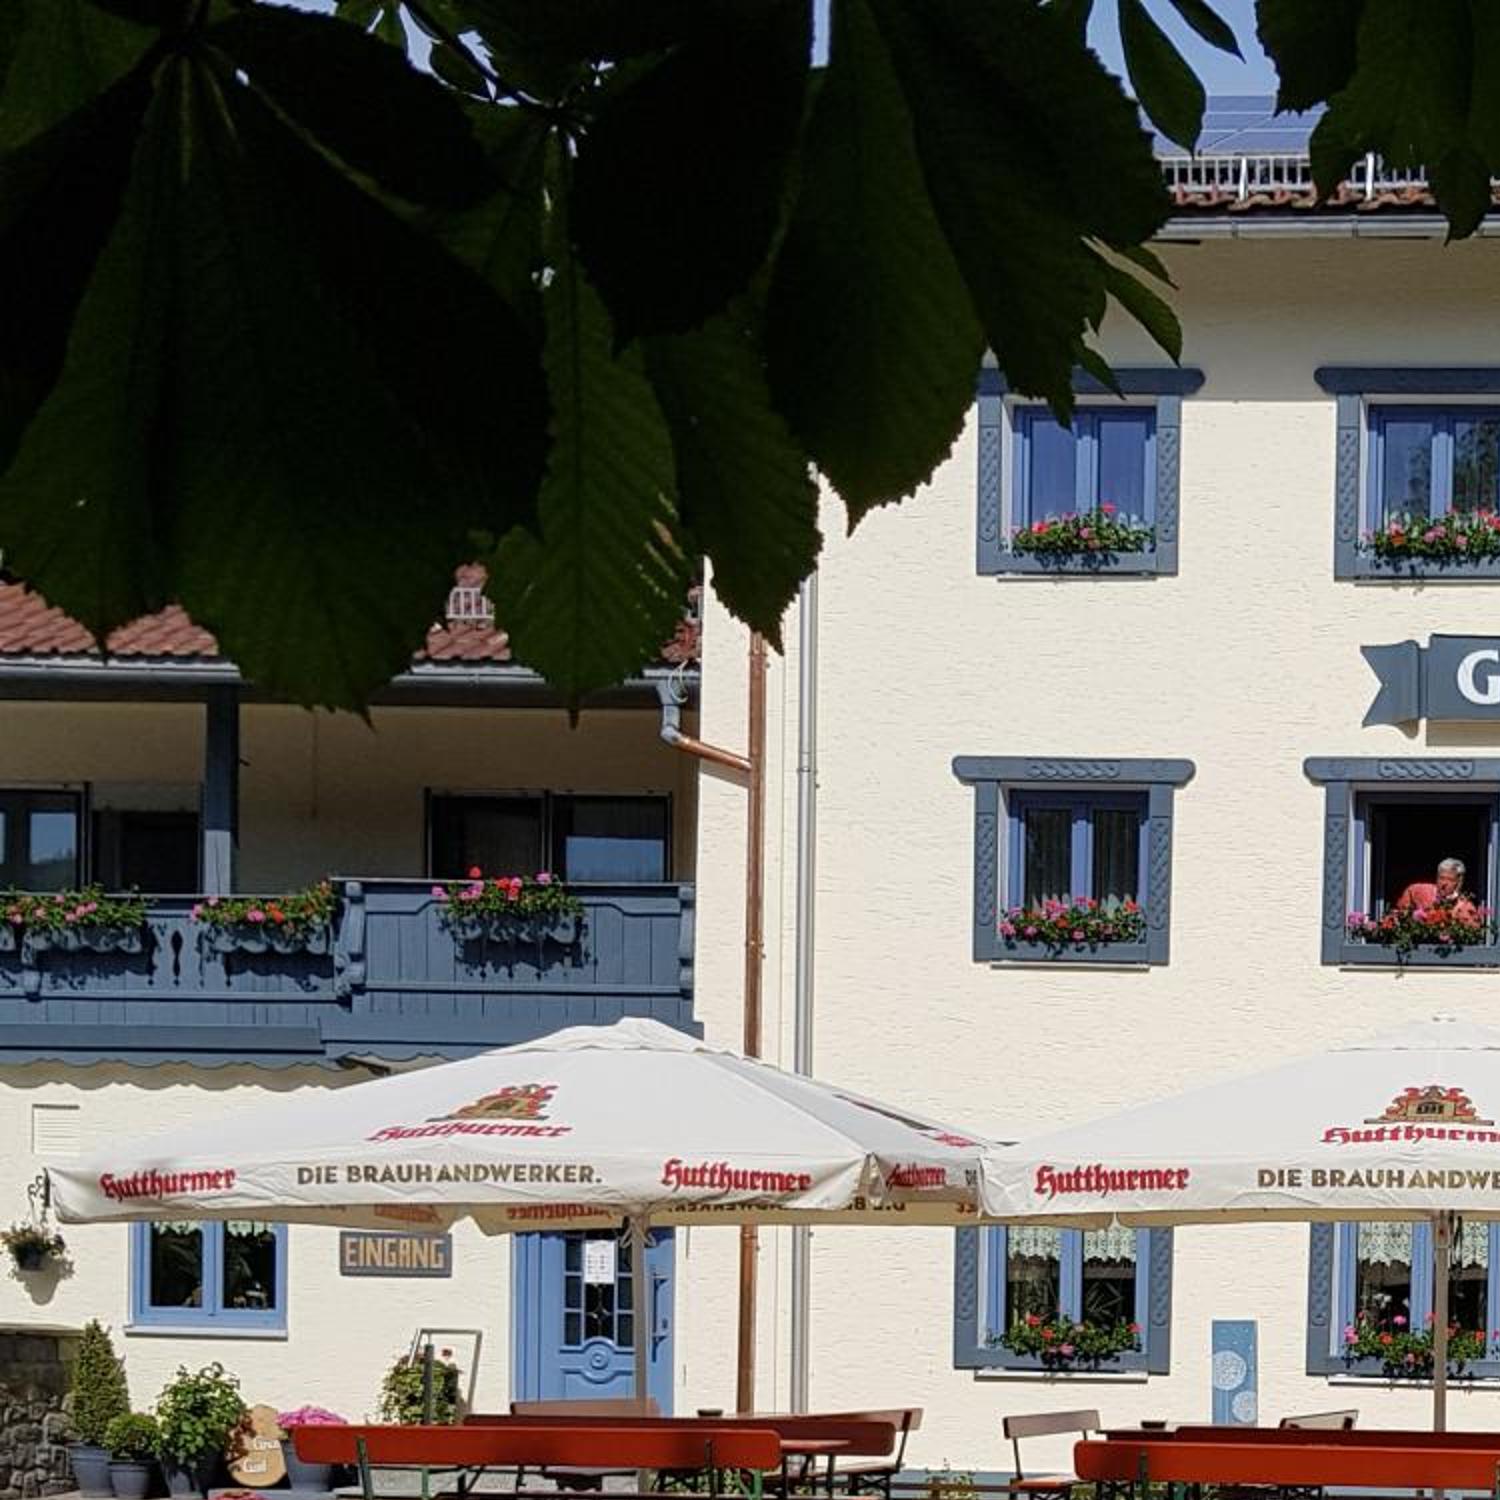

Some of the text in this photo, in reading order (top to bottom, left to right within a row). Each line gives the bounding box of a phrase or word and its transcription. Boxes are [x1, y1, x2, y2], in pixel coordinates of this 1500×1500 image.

[98, 1167, 237, 1201] Hutthurmer
[296, 1163, 603, 1186] DIE BRAUHANDWERKER.
[660, 1158, 813, 1194] Hutthurmer
[1033, 1163, 1191, 1200] Hutthurmer
[1257, 1169, 1303, 1188] DIE
[344, 1237, 444, 1269] EINGANG
